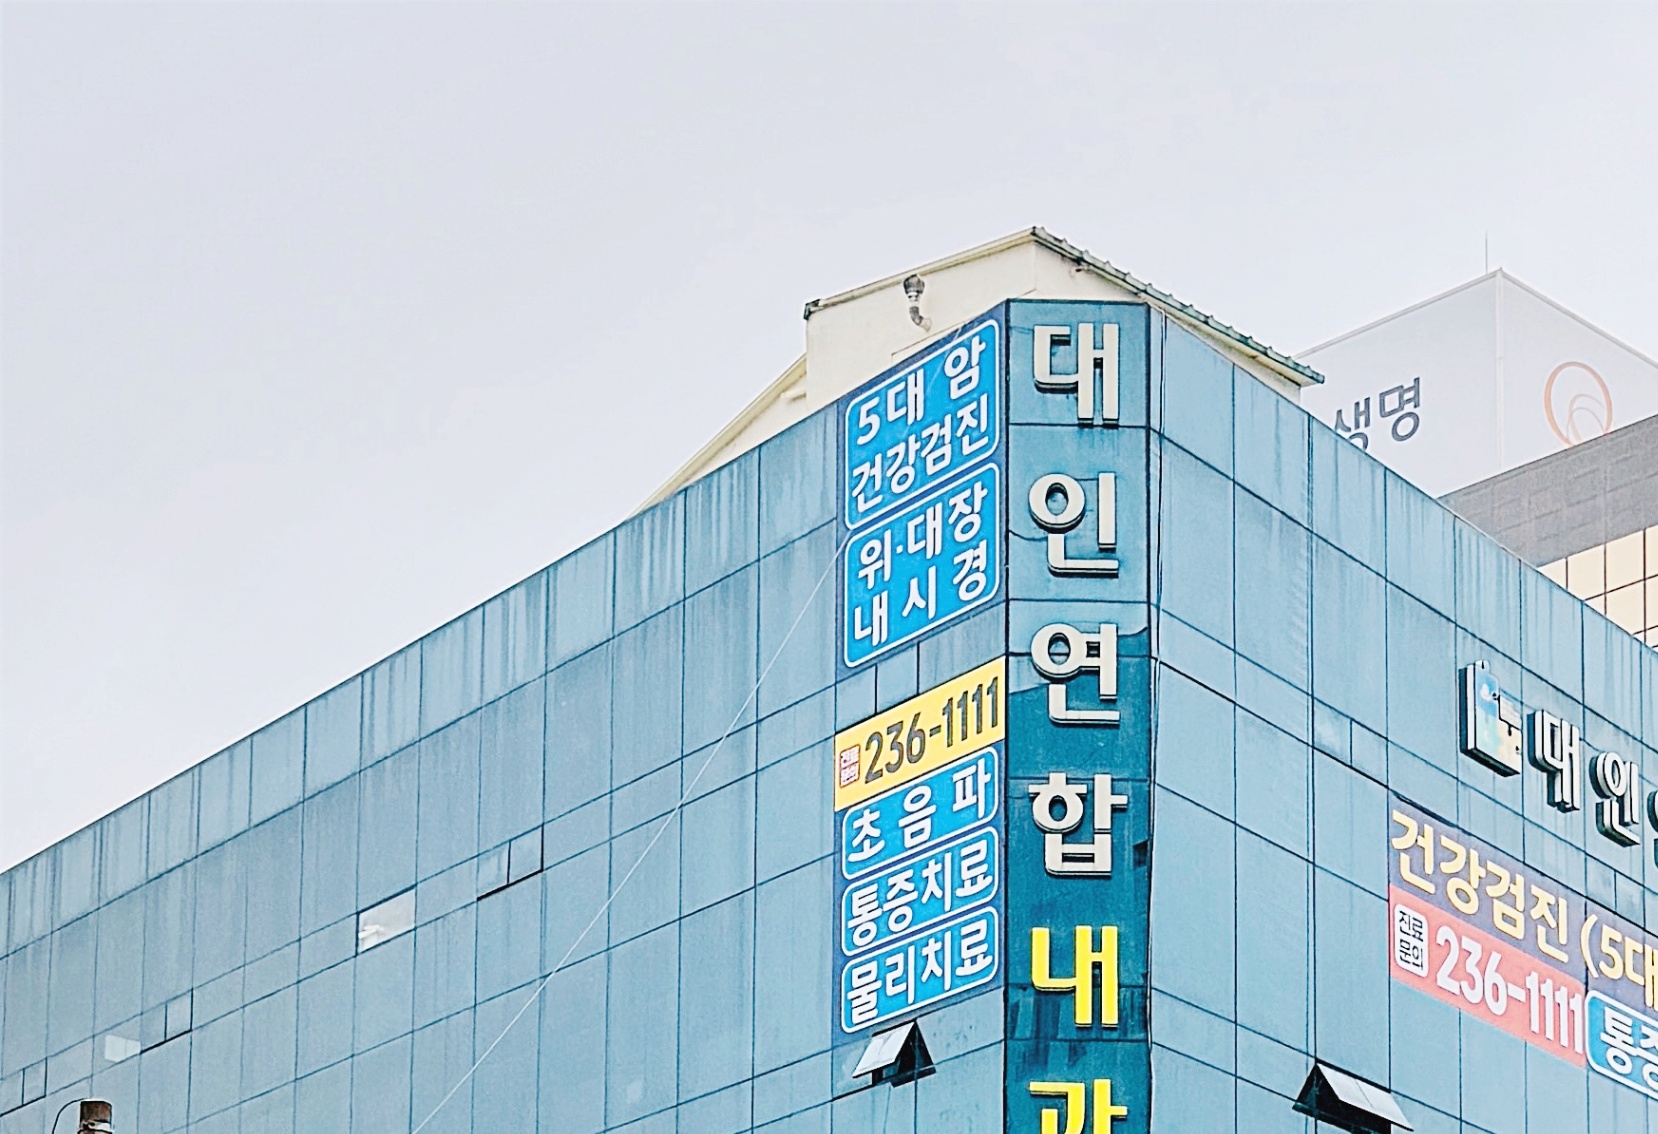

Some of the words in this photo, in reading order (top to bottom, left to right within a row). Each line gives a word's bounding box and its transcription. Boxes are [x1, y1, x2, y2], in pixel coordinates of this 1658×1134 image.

[855, 368, 925, 445] 5대
[943, 334, 985, 395] 암
[1334, 377, 1421, 453] 생명
[851, 393, 990, 513] 건강검진
[864, 675, 1000, 785] 236-1111
[846, 839, 994, 945] 통증치료
[1391, 810, 1568, 964] 건강검진
[1397, 908, 1425, 938] 진료
[845, 919, 994, 1026] 물리치료
[1397, 938, 1425, 974] 문의
[1435, 925, 1585, 1055] 236-1111
